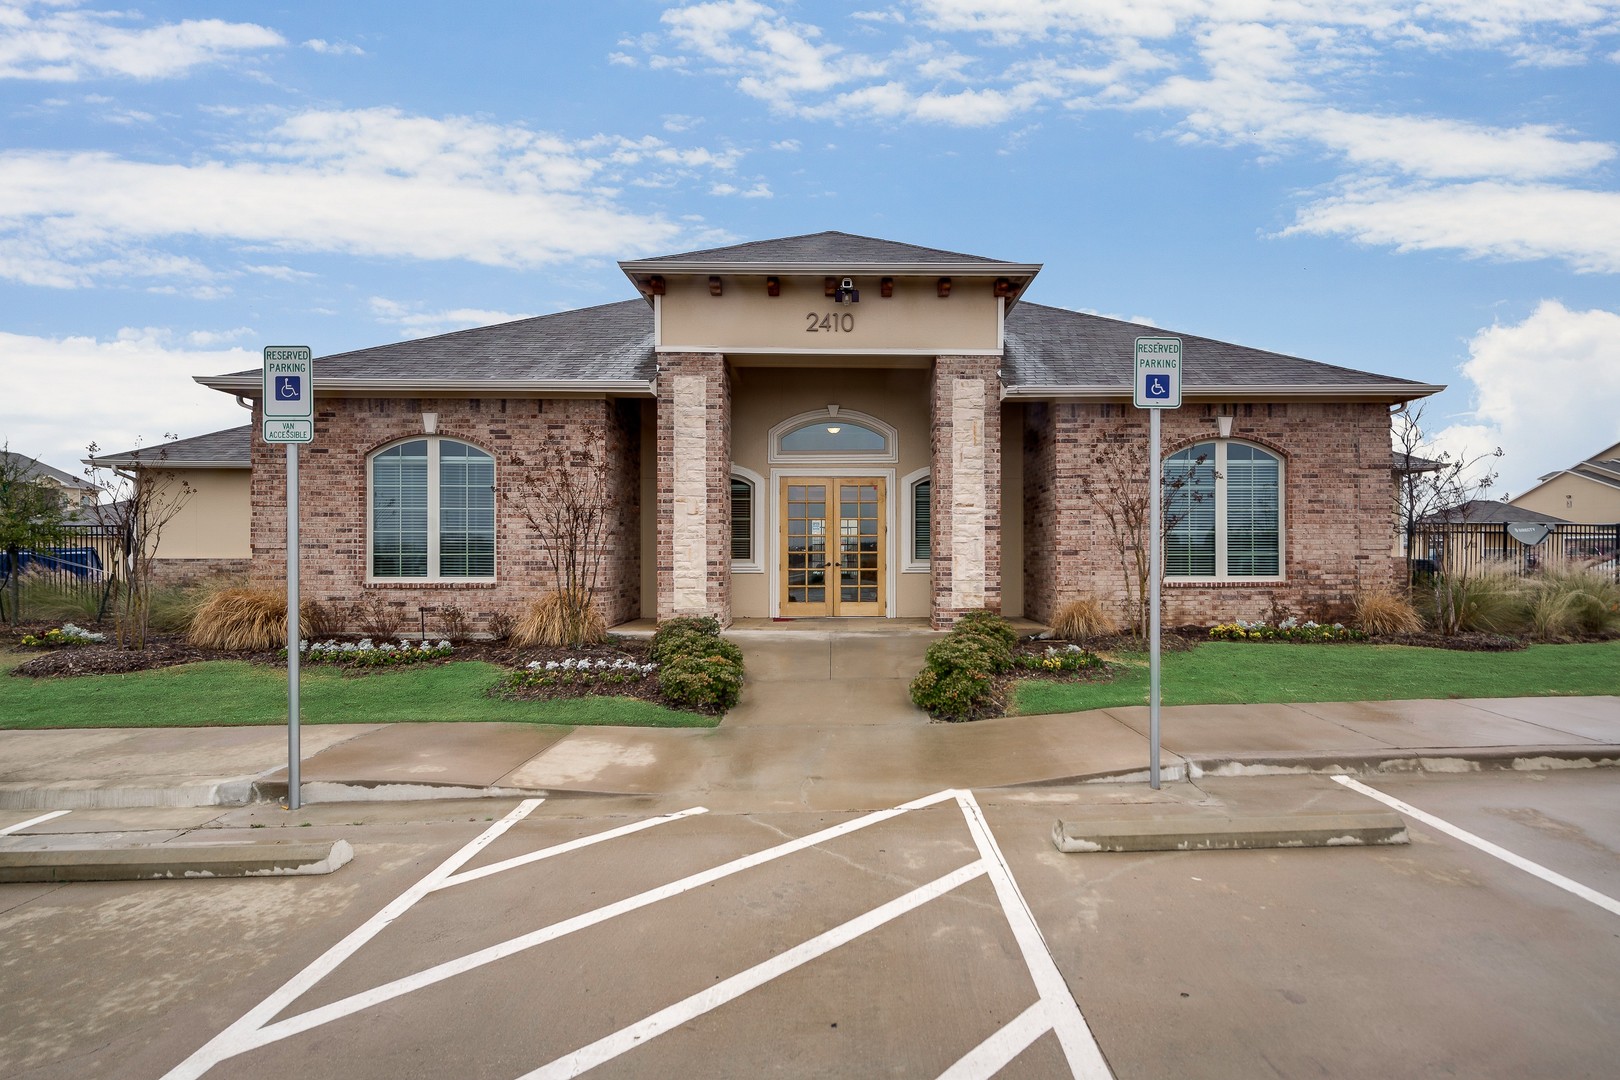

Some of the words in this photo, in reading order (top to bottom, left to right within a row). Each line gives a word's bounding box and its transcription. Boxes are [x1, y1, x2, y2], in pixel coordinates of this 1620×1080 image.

[805, 312, 855, 333] 2410
[1138, 343, 1179, 353] RESERVED
[266, 350, 309, 360] RESERVED
[269, 363, 306, 373] PARKING
[1139, 359, 1177, 368] PARKING
[269, 431, 307, 439] ACCESSIBLE
